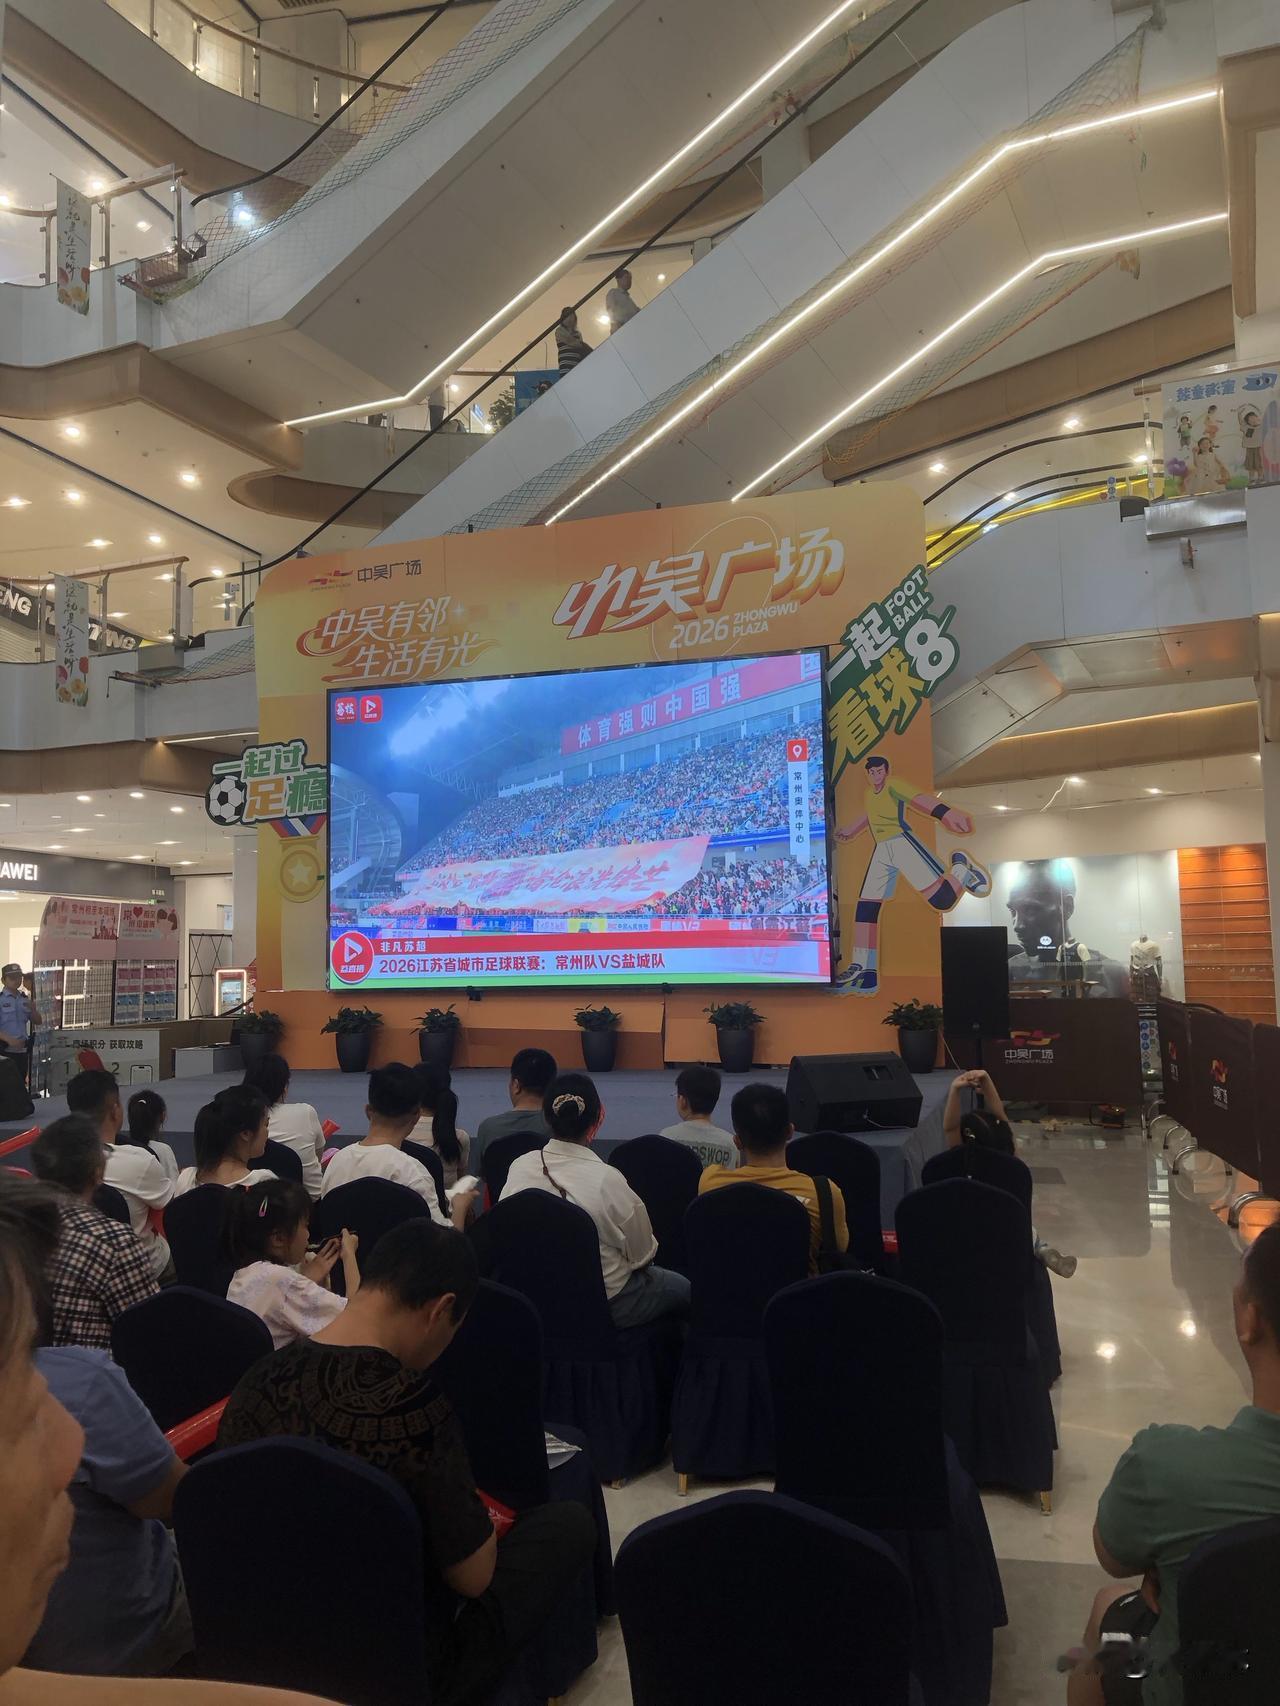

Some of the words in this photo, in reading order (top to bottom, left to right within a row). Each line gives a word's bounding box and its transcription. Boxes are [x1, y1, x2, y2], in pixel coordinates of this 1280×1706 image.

[357, 560, 421, 583] 中吴广场
[553, 527, 846, 640] 中吴广场
[884, 568, 925, 616] FOOT
[319, 596, 452, 648] 中吴有邻
[669, 616, 730, 648] 2026
[733, 602, 798, 624] ZHONGWU
[732, 621, 769, 637] PLAZA
[892, 591, 930, 631] BALL
[350, 632, 482, 680] 生活有光
[828, 607, 899, 692] 一起
[577, 672, 742, 748] 体育强则中国强
[829, 647, 925, 783] 看球
[214, 744, 303, 779] 一起过
[245, 770, 327, 820] 足瘾
[793, 771, 805, 844] 常州奥体中心
[0, 861, 38, 881] AWEI
[380, 940, 427, 953] 非凡苏超
[111, 1061, 120, 1075] 2
[1004, 1048, 1054, 1060] 中吴广场
